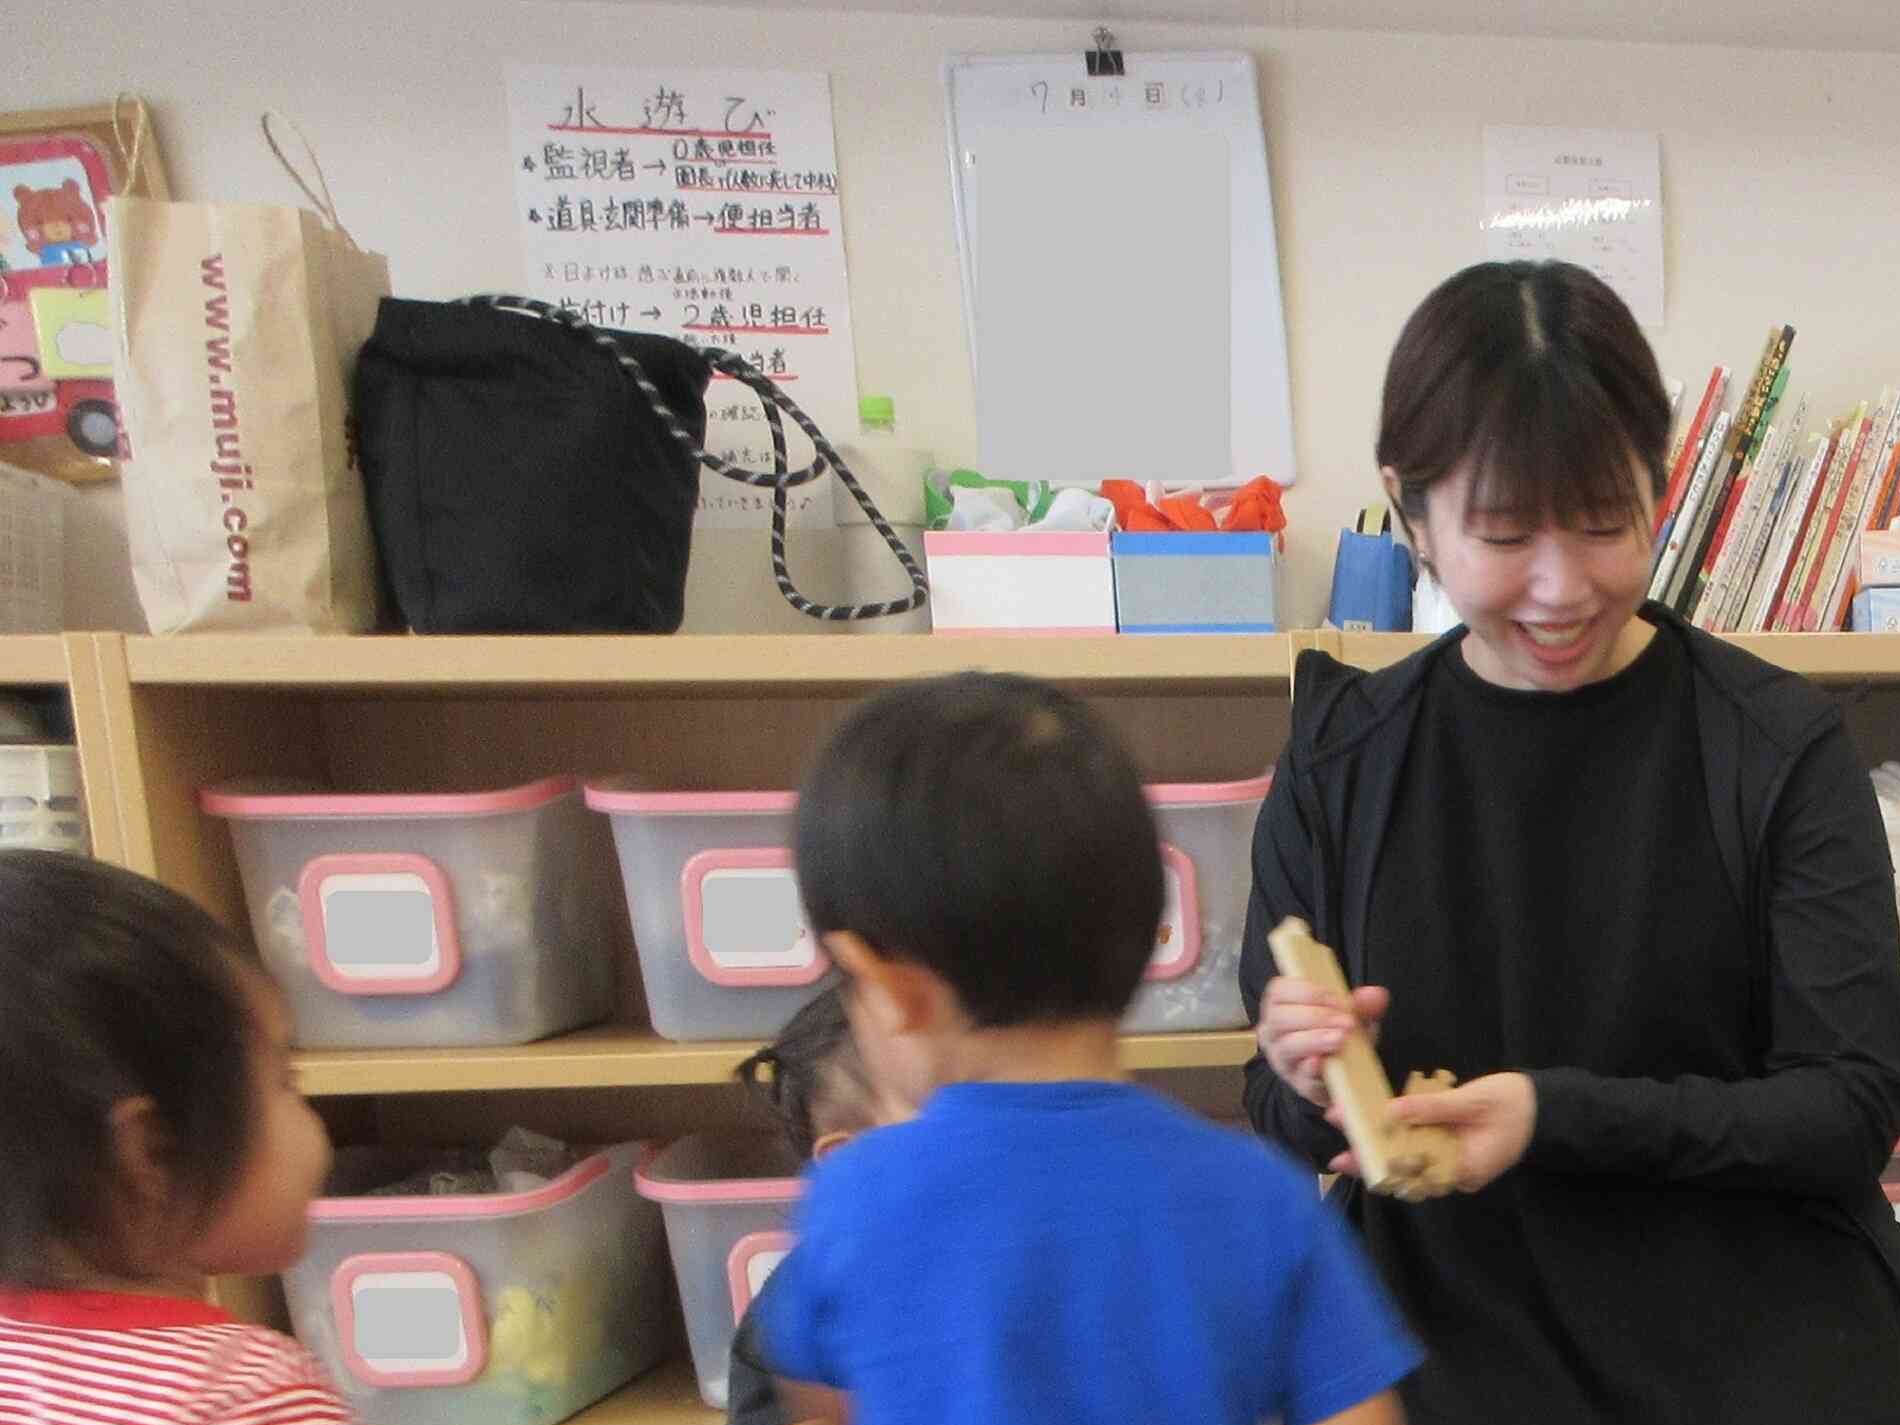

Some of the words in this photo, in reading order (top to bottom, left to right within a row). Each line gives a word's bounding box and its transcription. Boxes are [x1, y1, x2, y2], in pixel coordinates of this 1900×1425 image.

[562, 85, 776, 131] 水遊び
[543, 144, 636, 182] 監視者
[200, 252, 253, 601] www.muji.com
